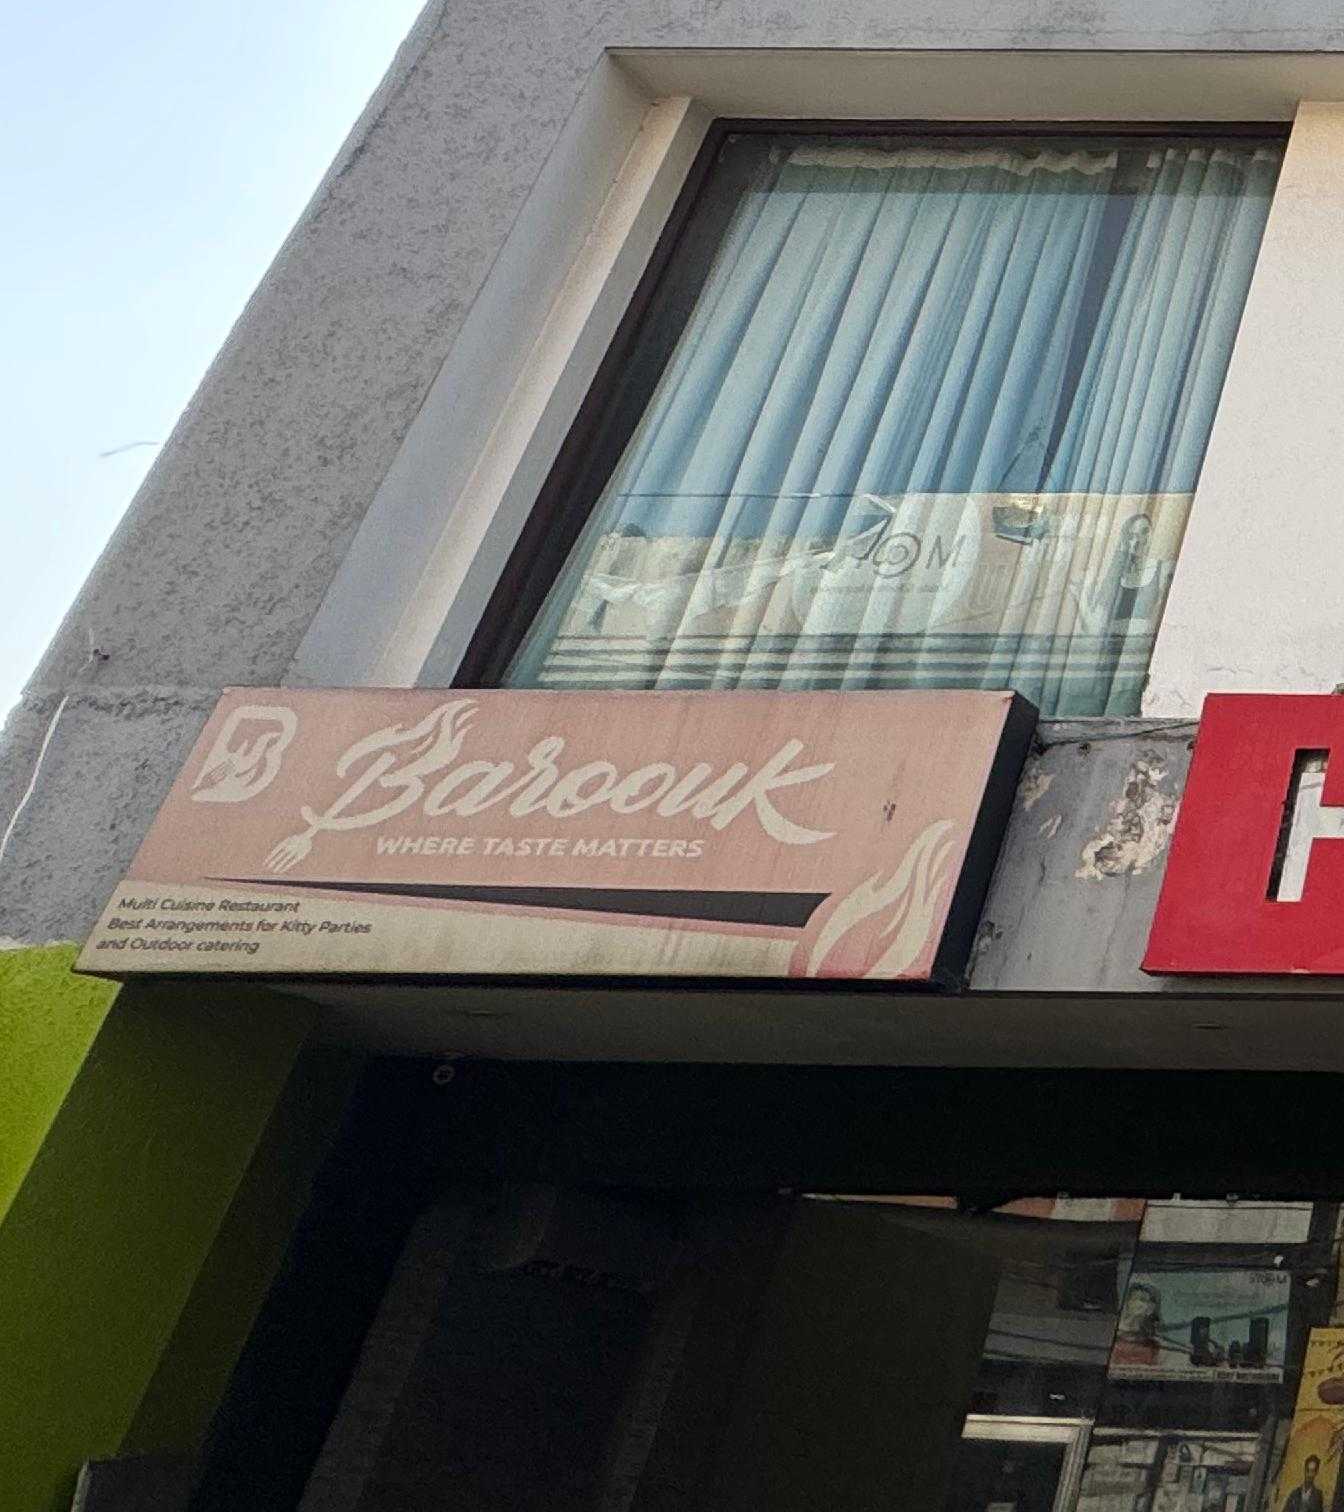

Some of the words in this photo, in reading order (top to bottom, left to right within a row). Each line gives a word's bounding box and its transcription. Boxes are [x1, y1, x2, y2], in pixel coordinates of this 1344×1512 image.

[376, 836, 476, 856] WHERE
[483, 837, 573, 856] TASTE
[572, 838, 705, 858] MATTERS
[118, 898, 157, 911] Multi
[160, 898, 215, 912] Cuisine
[218, 899, 300, 913] Restaurant
[107, 918, 141, 930] Best
[144, 918, 254, 934] Arrangements
[256, 919, 279, 932] for
[280, 919, 317, 935] Kitty
[319, 921, 373, 934] Parties
[95, 938, 128, 951] and
[130, 938, 192, 952] Outdoor
[196, 940, 260, 955] catering
